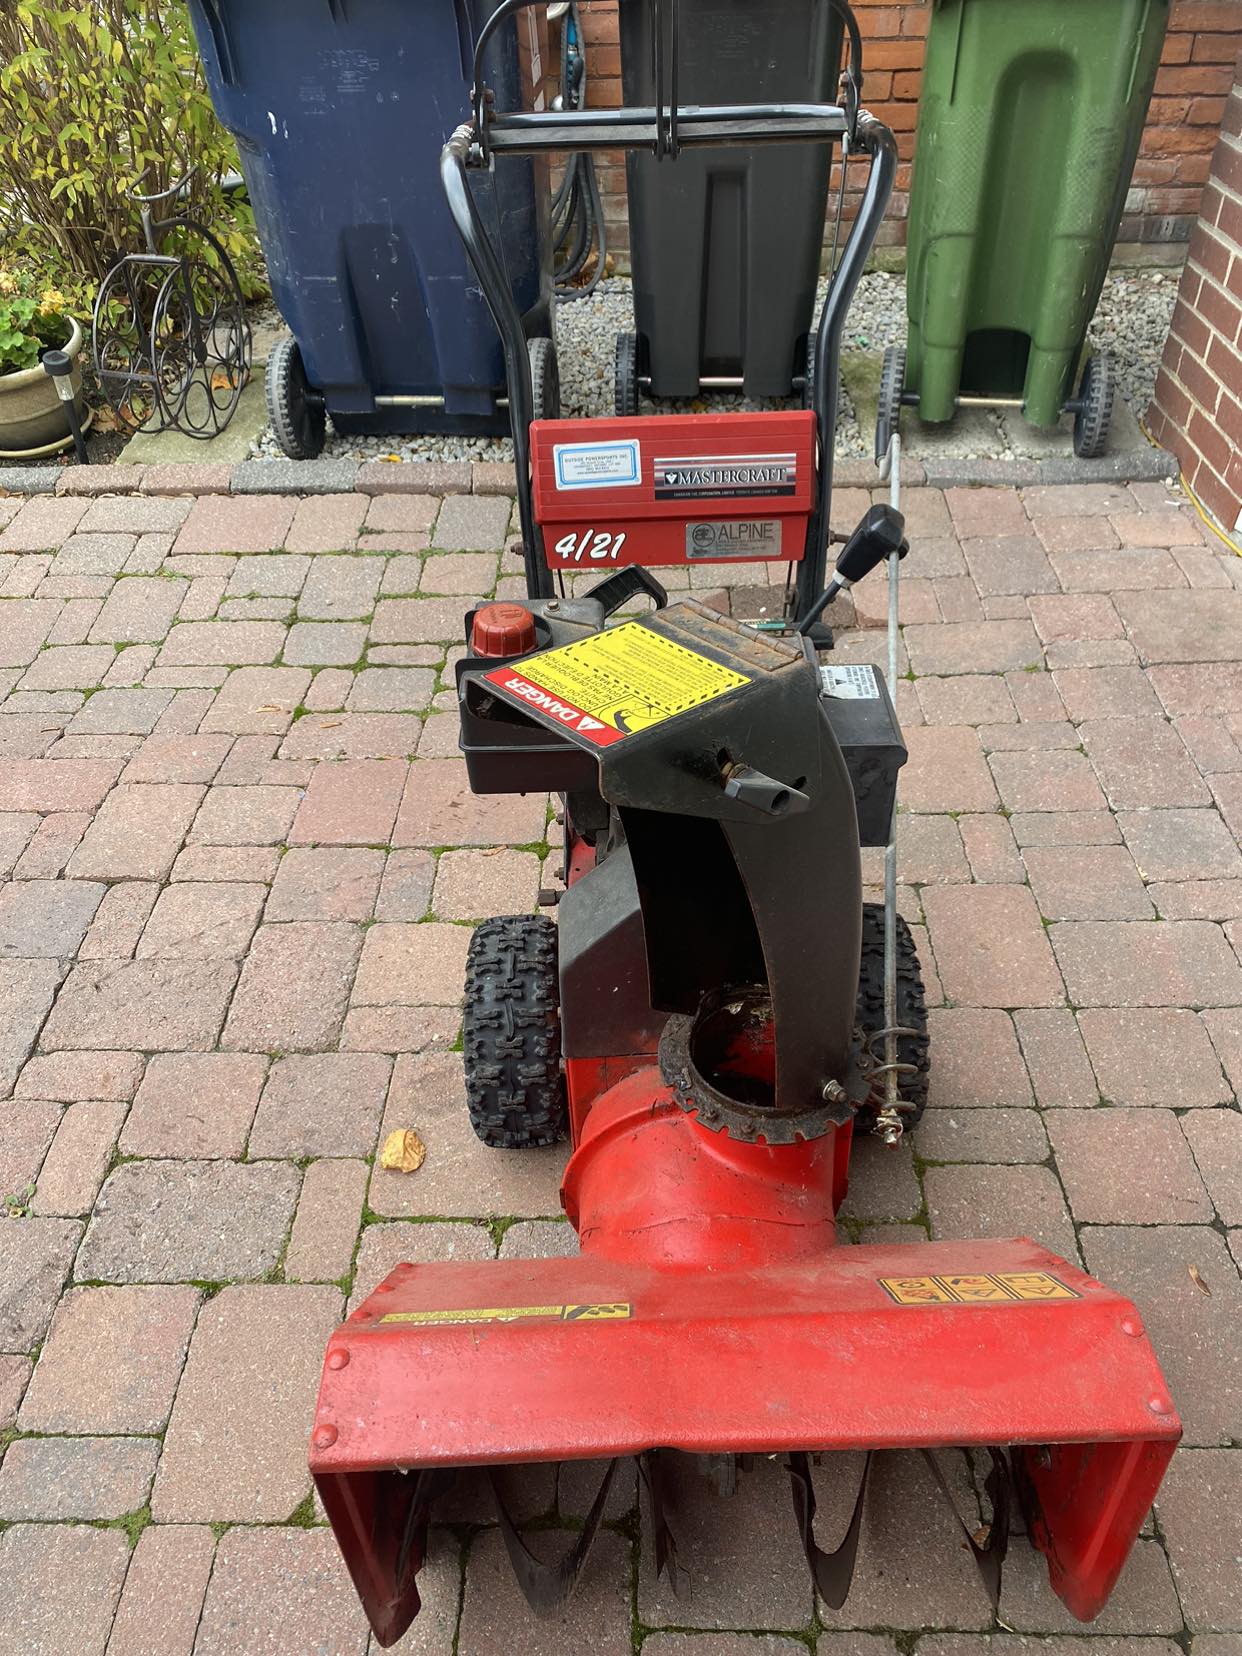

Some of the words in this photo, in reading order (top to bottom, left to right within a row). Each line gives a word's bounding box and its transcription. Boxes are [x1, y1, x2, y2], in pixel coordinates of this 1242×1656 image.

[679, 468, 786, 485] MASTERCRAFT
[718, 523, 774, 540] ALPINE
[555, 528, 626, 562] 4/21
[521, 671, 550, 686] HANDS
[523, 665, 568, 689] DISCHARGE
[546, 685, 564, 694] USE
[581, 675, 623, 697] GOULOTTE
[586, 685, 604, 694] PAS
[504, 678, 580, 721] DANGER
[560, 693, 580, 703] NOT
[564, 688, 600, 707] UNCLOG
[600, 692, 615, 700] NE
